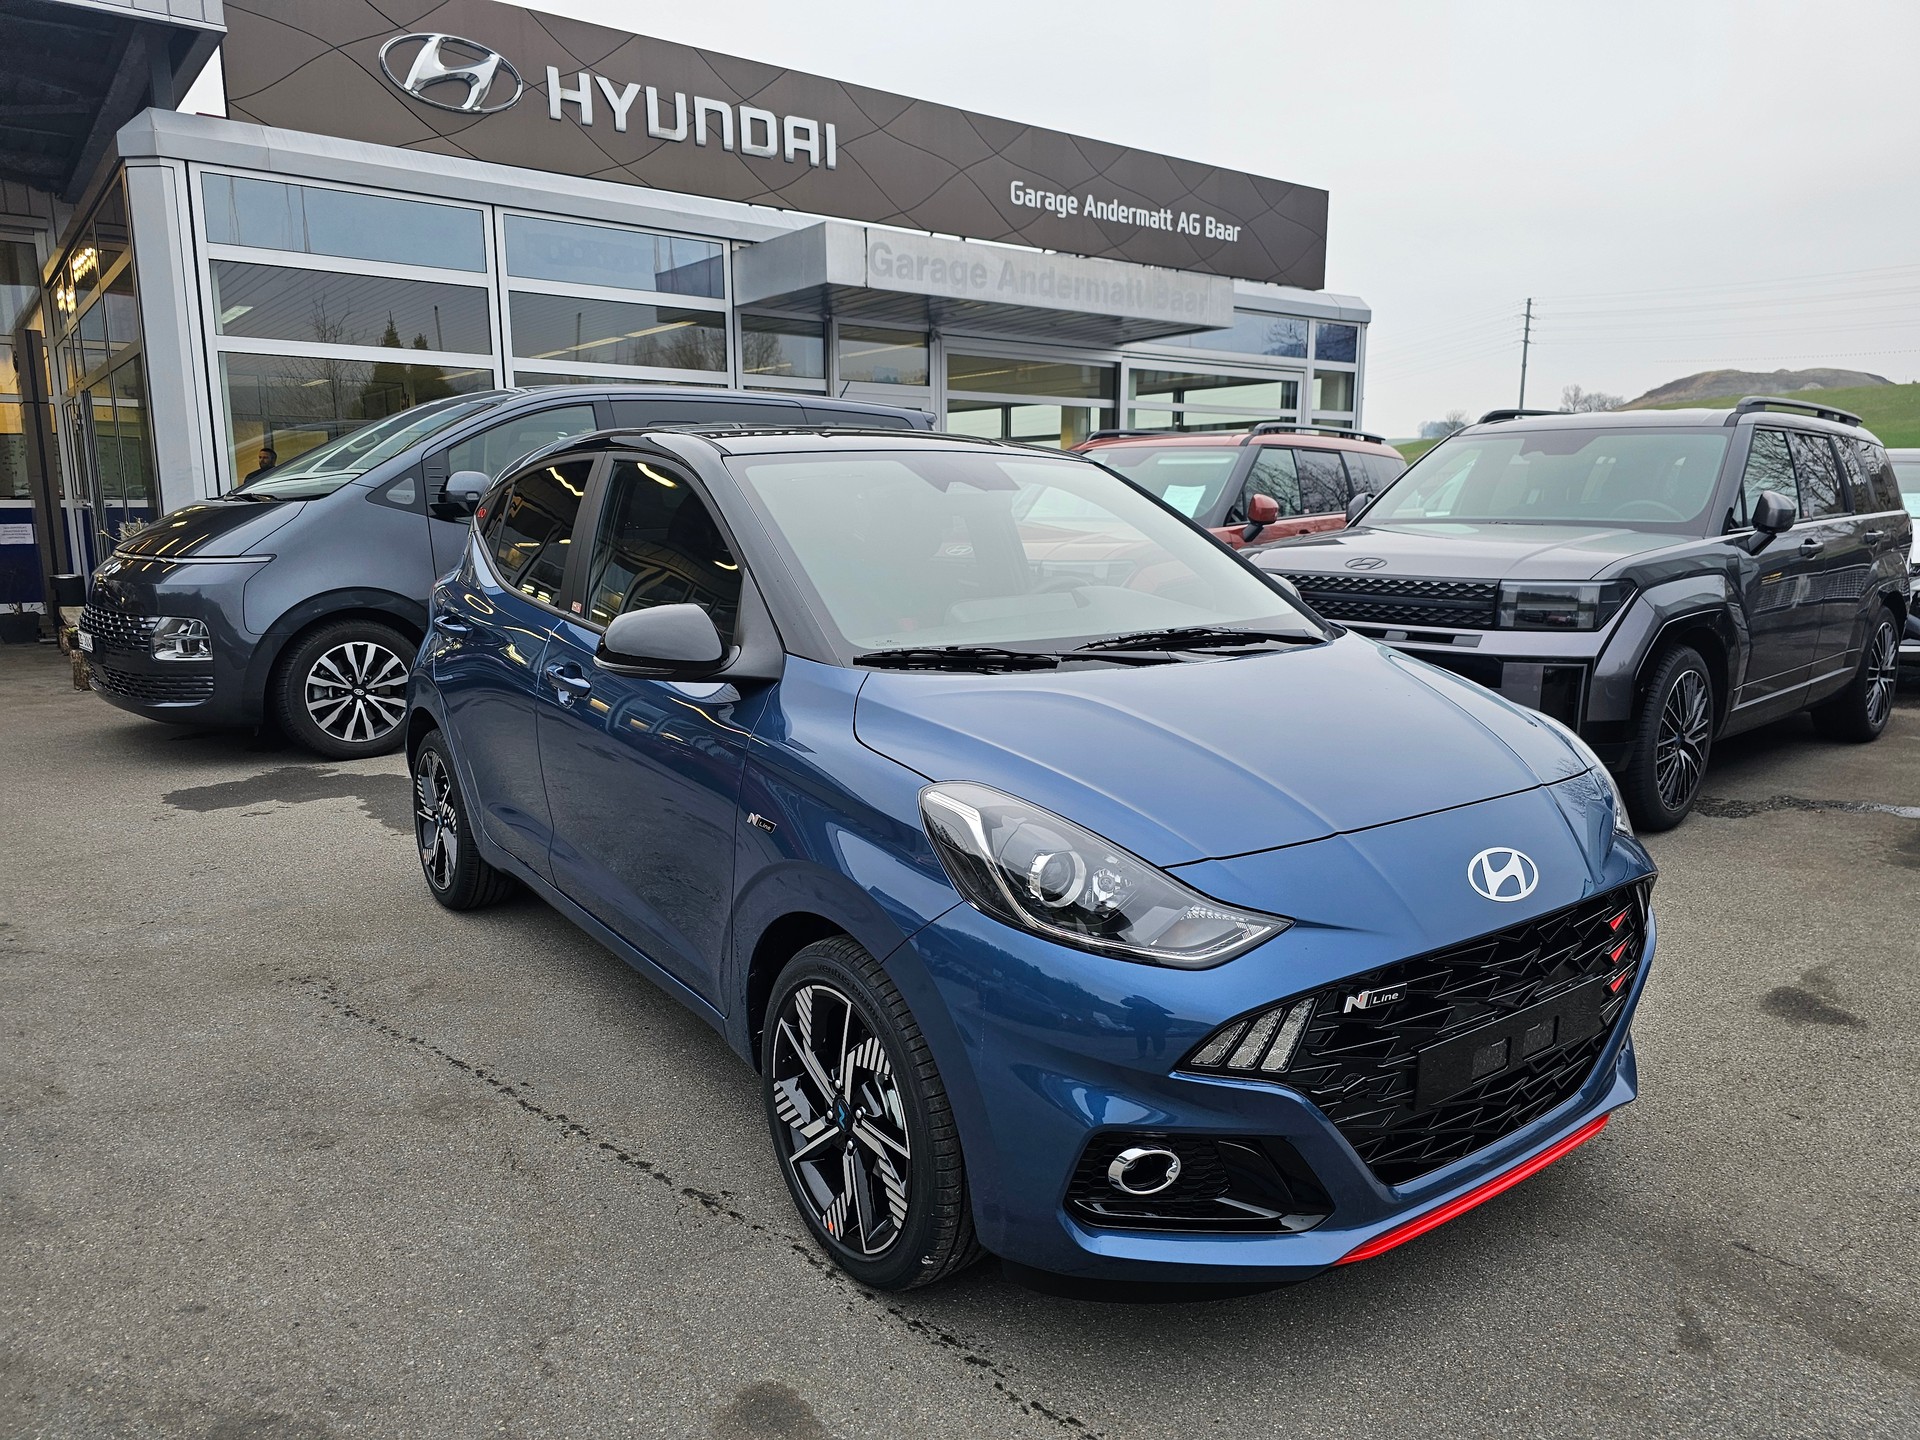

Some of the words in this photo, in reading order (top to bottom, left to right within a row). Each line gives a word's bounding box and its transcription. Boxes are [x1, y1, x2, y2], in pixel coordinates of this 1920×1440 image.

[546, 65, 837, 170] HYUNDAI
[1010, 180, 1078, 218] Garage
[1083, 194, 1173, 232] Andermatt
[1177, 211, 1201, 236] AG
[1205, 216, 1242, 242] Baar
[869, 241, 988, 294] Garage
[996, 259, 1144, 303] Andermatt
[1156, 274, 1207, 313] Baar
[1372, 992, 1399, 1005] Line
